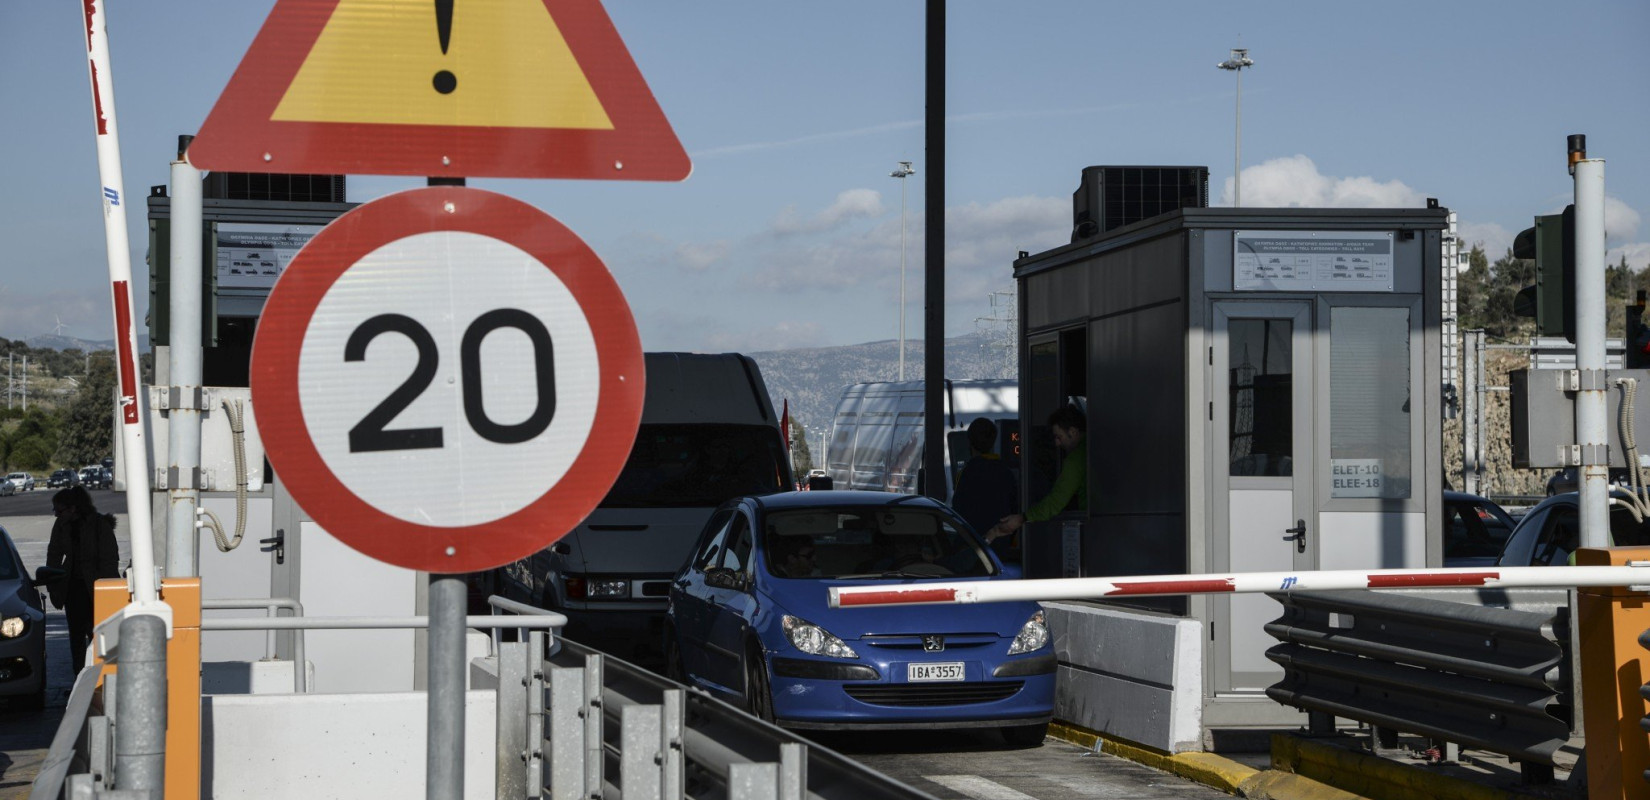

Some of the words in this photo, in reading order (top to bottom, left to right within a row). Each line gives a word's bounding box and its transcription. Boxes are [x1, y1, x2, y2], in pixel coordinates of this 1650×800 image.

[344, 307, 557, 453] 20
[1333, 465, 1379, 475] ELET-10
[1333, 478, 1380, 488] ELEE-18
